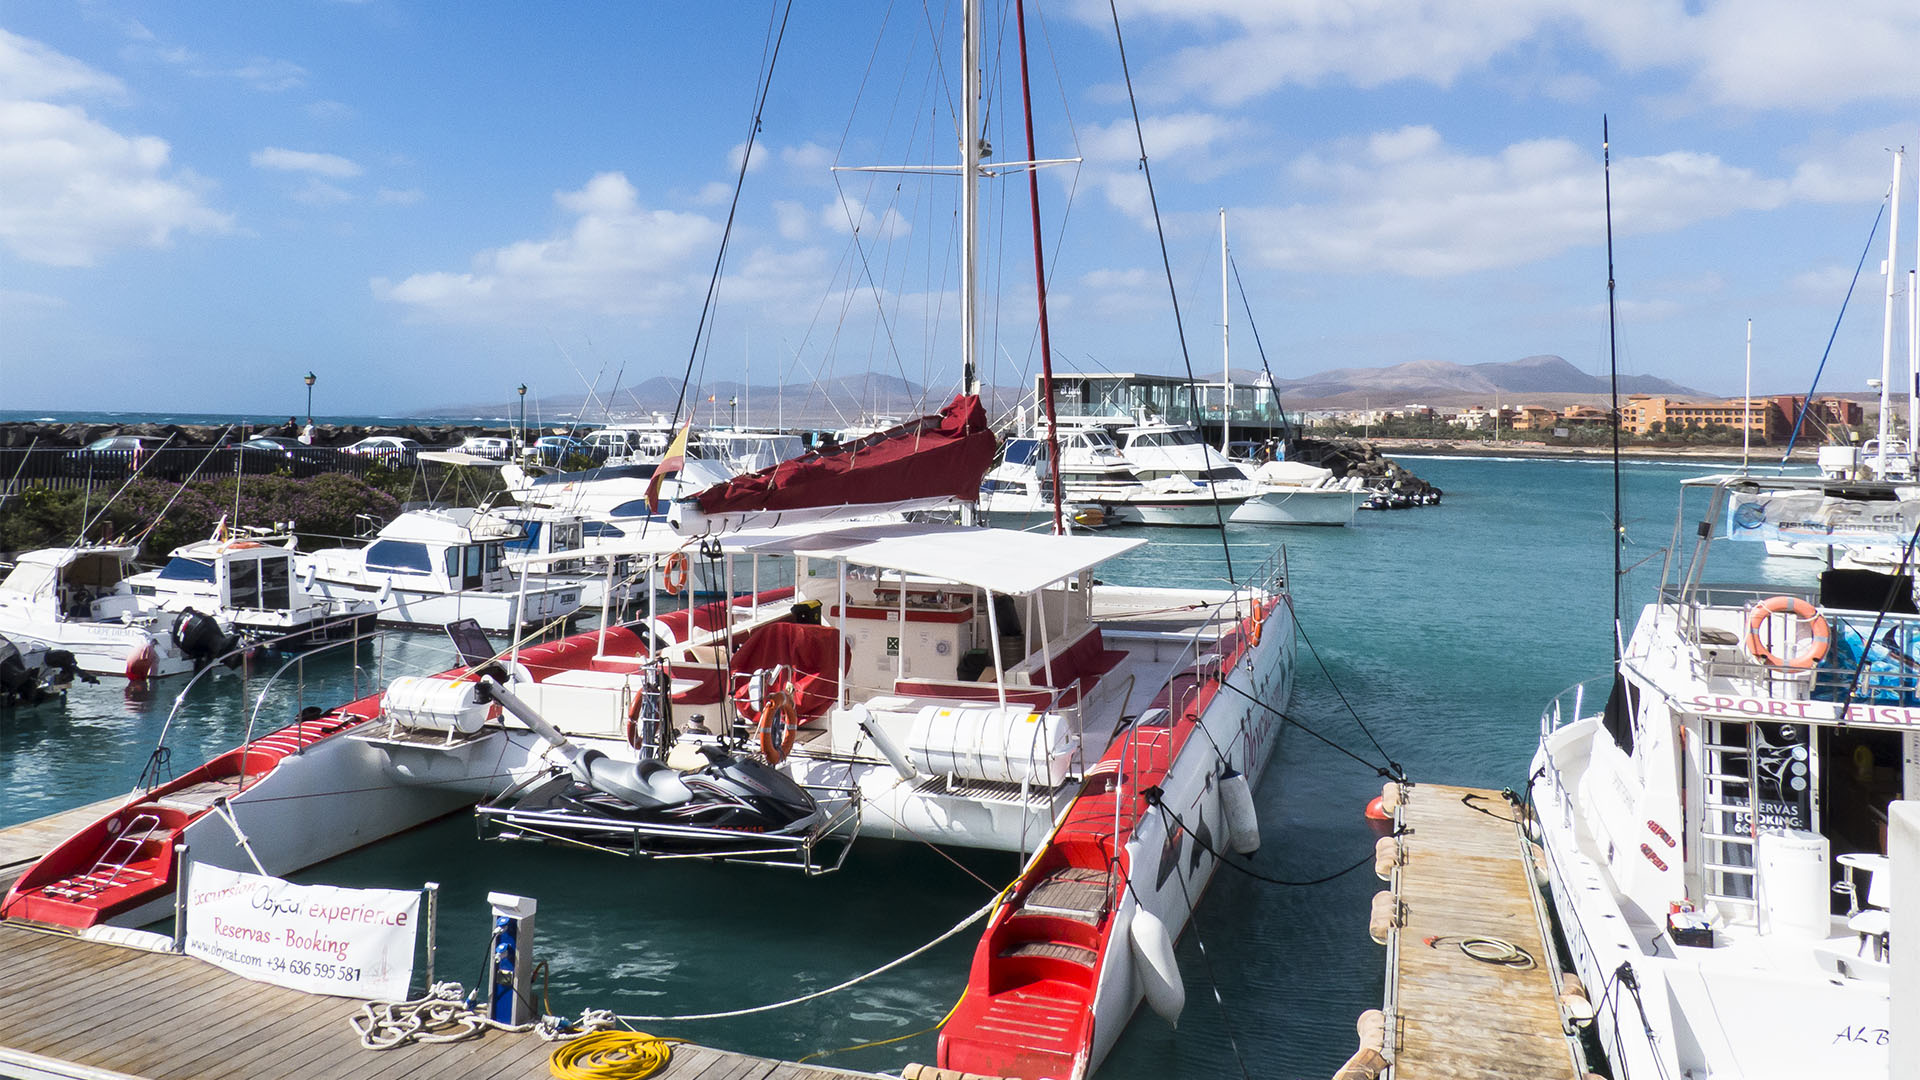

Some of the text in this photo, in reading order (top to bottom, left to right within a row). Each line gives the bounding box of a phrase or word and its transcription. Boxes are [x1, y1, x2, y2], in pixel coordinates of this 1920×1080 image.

[1693, 695, 1811, 718] SPORT
[1735, 801, 1799, 816] REERVAS
[309, 904, 408, 926] experience
[214, 917, 271, 944] Reservas
[286, 929, 350, 961] Booking
[191, 939, 361, 982] www.obycat.com +34 636 595 581
